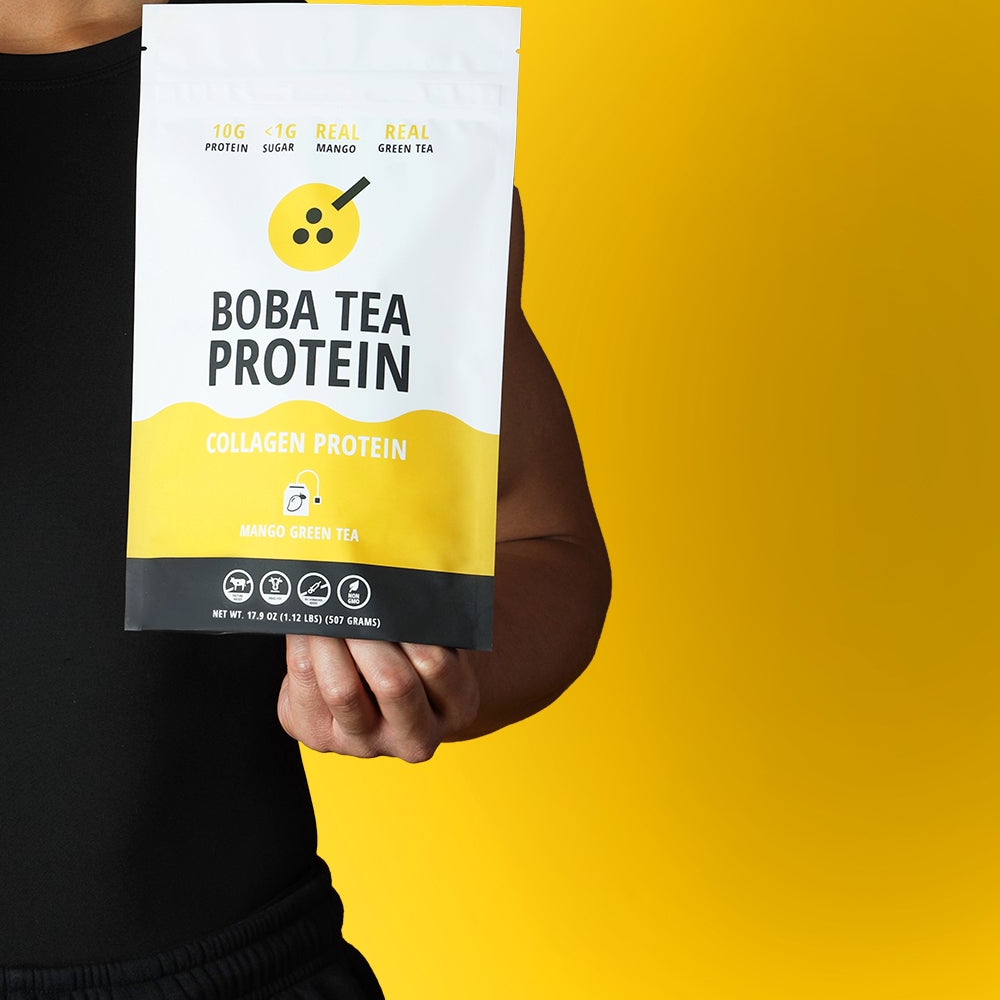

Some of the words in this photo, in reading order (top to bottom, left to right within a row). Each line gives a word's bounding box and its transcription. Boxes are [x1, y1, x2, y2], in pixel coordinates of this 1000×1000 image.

[213, 123, 245, 139] 10G
[264, 123, 297, 139] <1G
[315, 123, 360, 141] REAL
[385, 124, 430, 140] REAL
[205, 142, 248, 153] PROTEIN
[262, 142, 295, 153] SUGAR
[316, 143, 356, 154] MANGO
[378, 143, 411, 154] GREEN
[416, 143, 434, 153] TEA
[211, 288, 319, 332] BOBA
[335, 290, 411, 336] TEA
[208, 338, 411, 393] PROTEIN
[206, 431, 305, 454] COLLAGEN
[314, 433, 407, 461] PROTEIN
[239, 524, 285, 538] MANGO
[290, 525, 331, 540] GREEN
[336, 527, 359, 542] TEA
[212, 609, 227, 619] NET
[229, 610, 244, 619] WT.
[247, 611, 263, 620] 17.9
[267, 612, 278, 621] OZ
[280, 612, 301, 622] (1.12
[304, 614, 323, 625] LBS)
[325, 614, 344, 626] (507
[347, 616, 381, 628] GRAMS)
